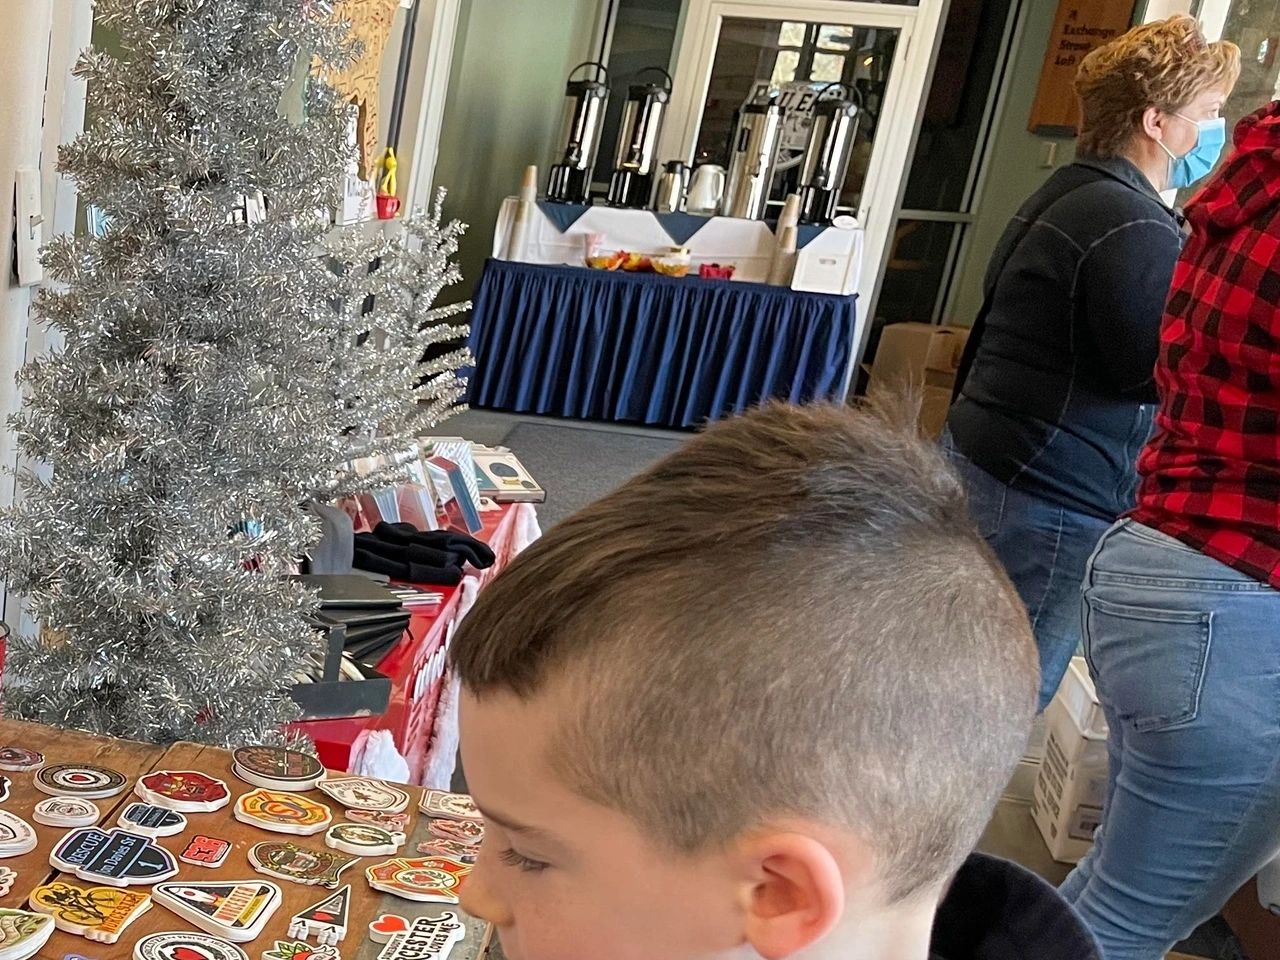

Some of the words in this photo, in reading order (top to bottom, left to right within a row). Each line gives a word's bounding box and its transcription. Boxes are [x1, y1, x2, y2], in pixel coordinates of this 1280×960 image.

[67, 832, 104, 865] RESCUE
[103, 842, 131, 869] Davies
[138, 860, 163, 870] 1
[426, 932, 450, 954] LOVES
[441, 922, 461, 933] ME
